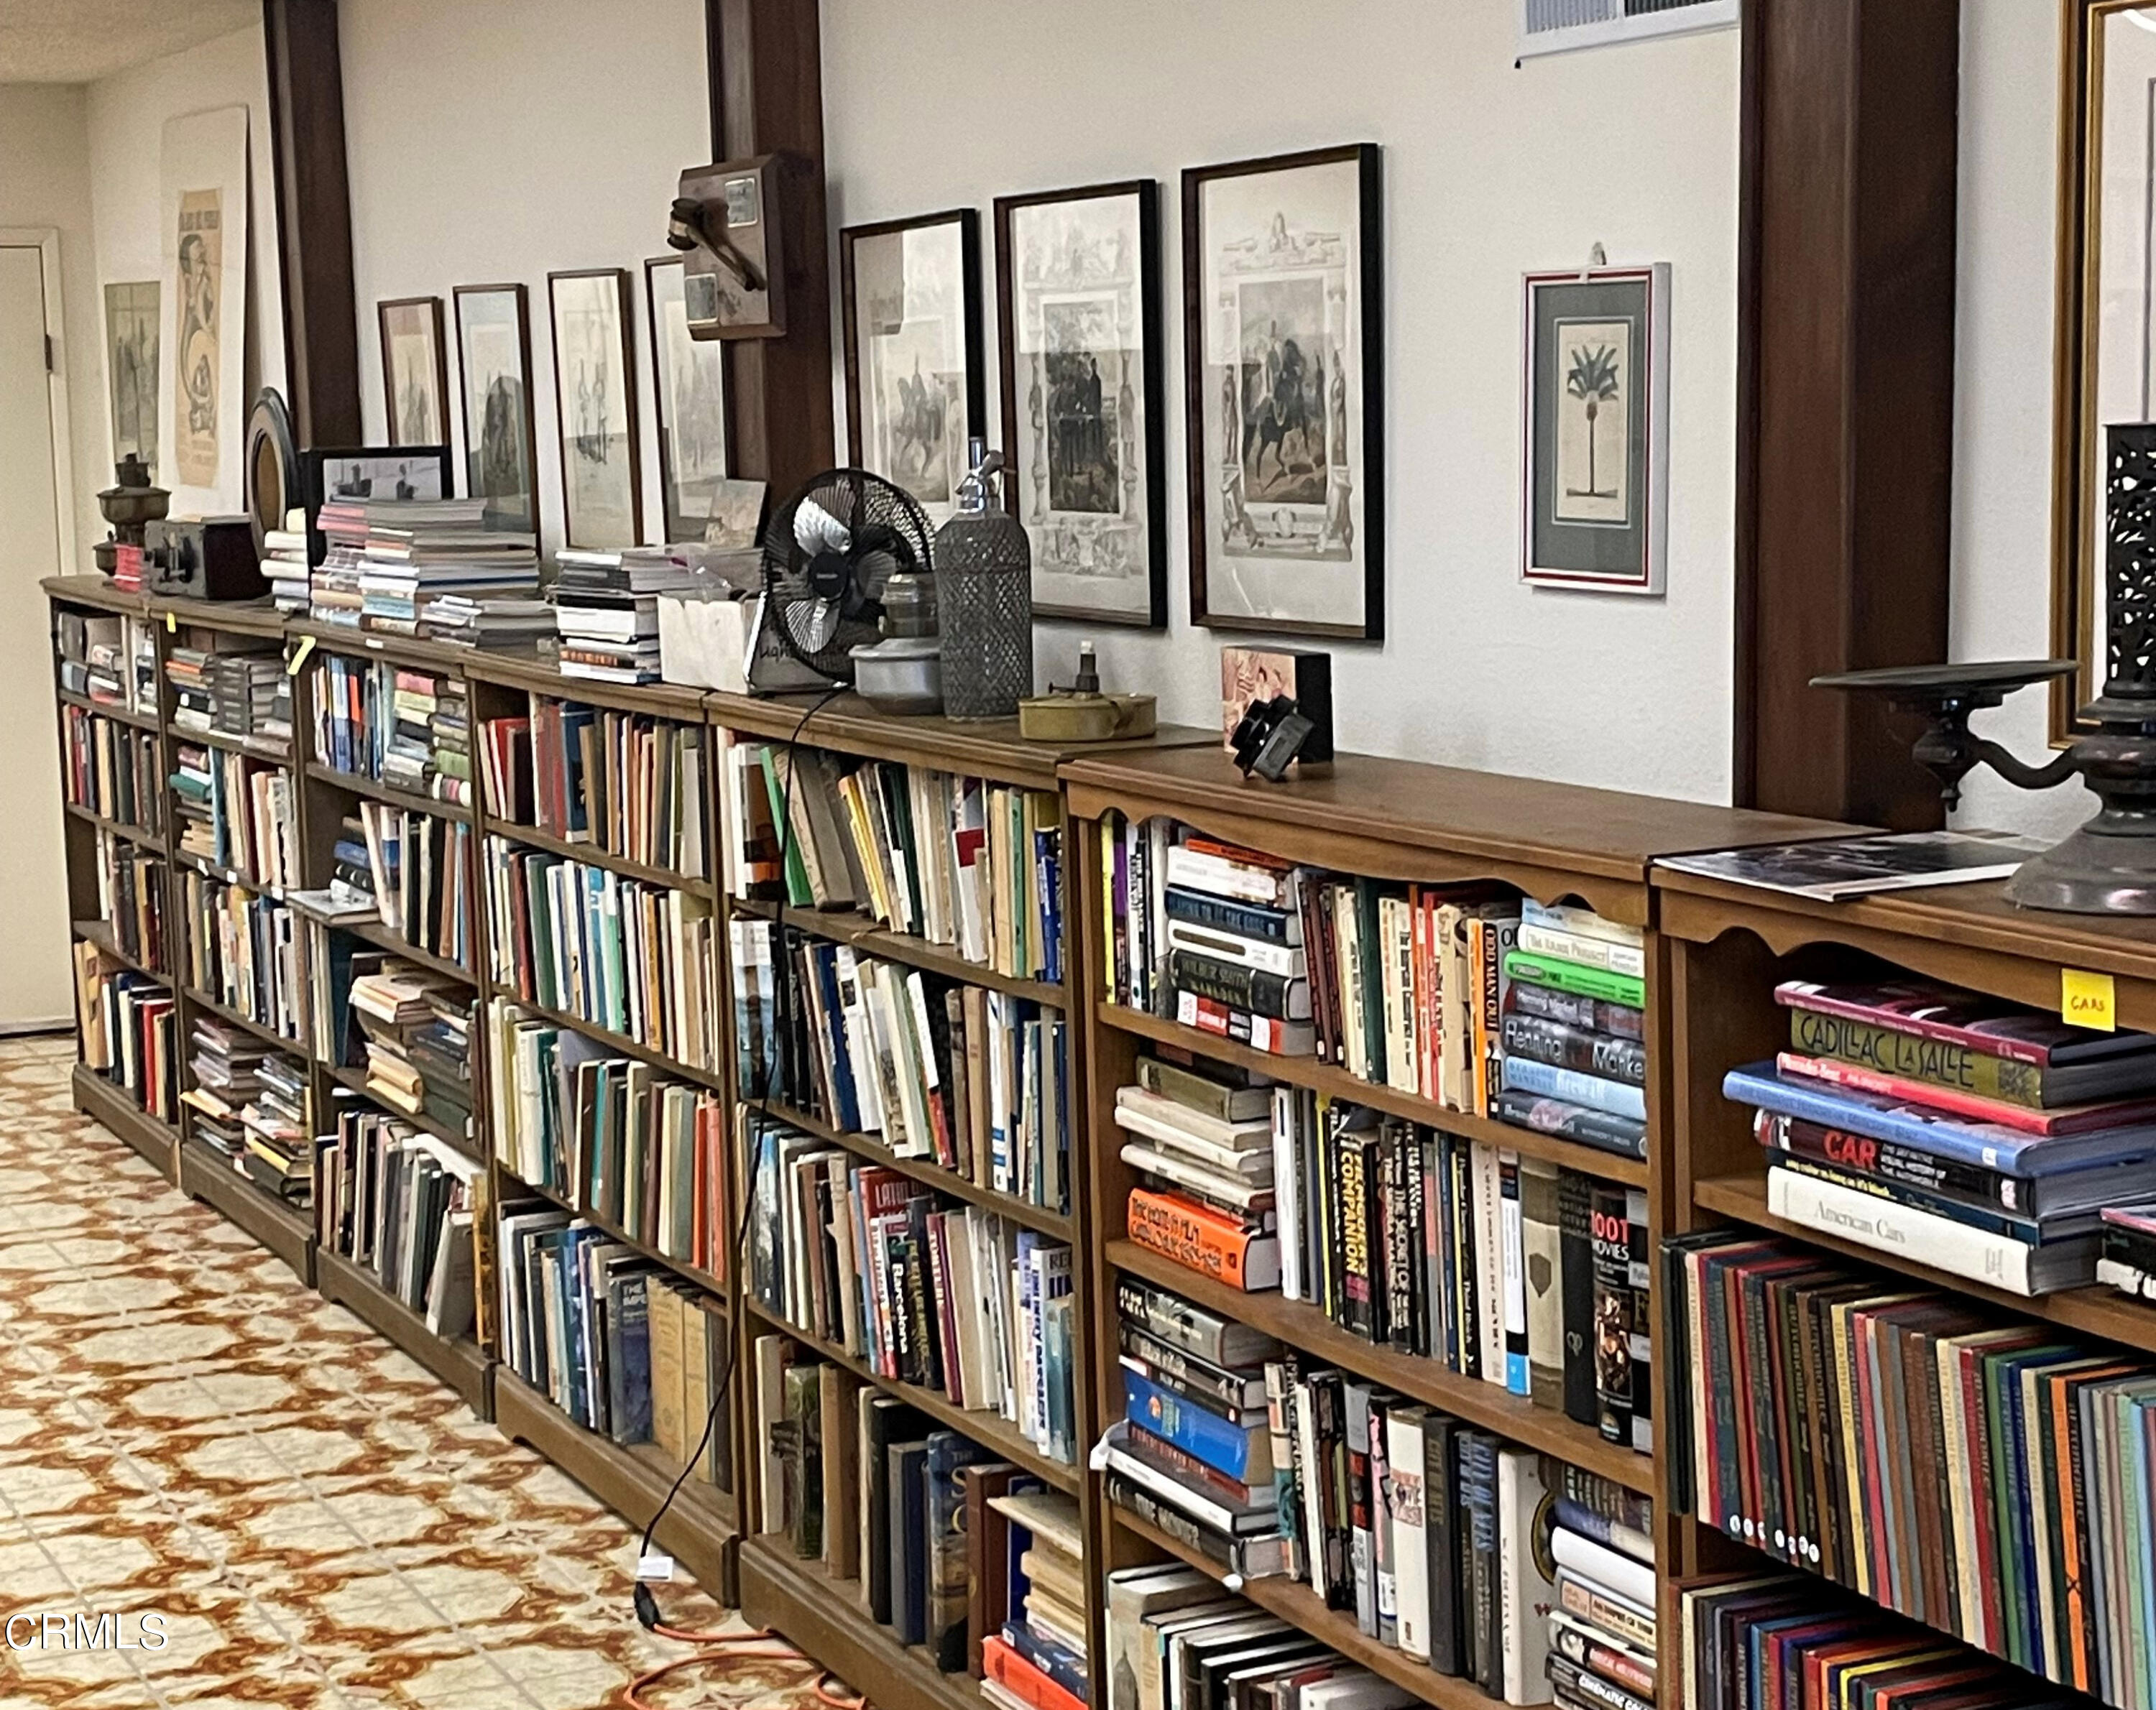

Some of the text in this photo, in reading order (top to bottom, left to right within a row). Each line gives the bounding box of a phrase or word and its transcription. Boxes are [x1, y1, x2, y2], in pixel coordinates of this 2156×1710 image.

[1485, 928, 1499, 1029] ODD MAN OUT
[1506, 1019, 1562, 1064] Henning
[1800, 1014, 1886, 1069] CADILLAC
[1823, 1129, 1878, 1172] CAR
[1340, 1151, 1359, 1273] COMPANION
[1353, 1152, 1368, 1278] FILMGOER'S
[1393, 1189, 1407, 1215] THE
[1815, 1199, 1874, 1235] American
[1876, 1219, 1906, 1244] Cars
[1395, 1219, 1410, 1267] SECRET
[1590, 1208, 1628, 1244] 1001
[1396, 1269, 1410, 1291] OF
[891, 1263, 908, 1354] Barcelona
[1473, 1443, 1493, 1481] CITY
